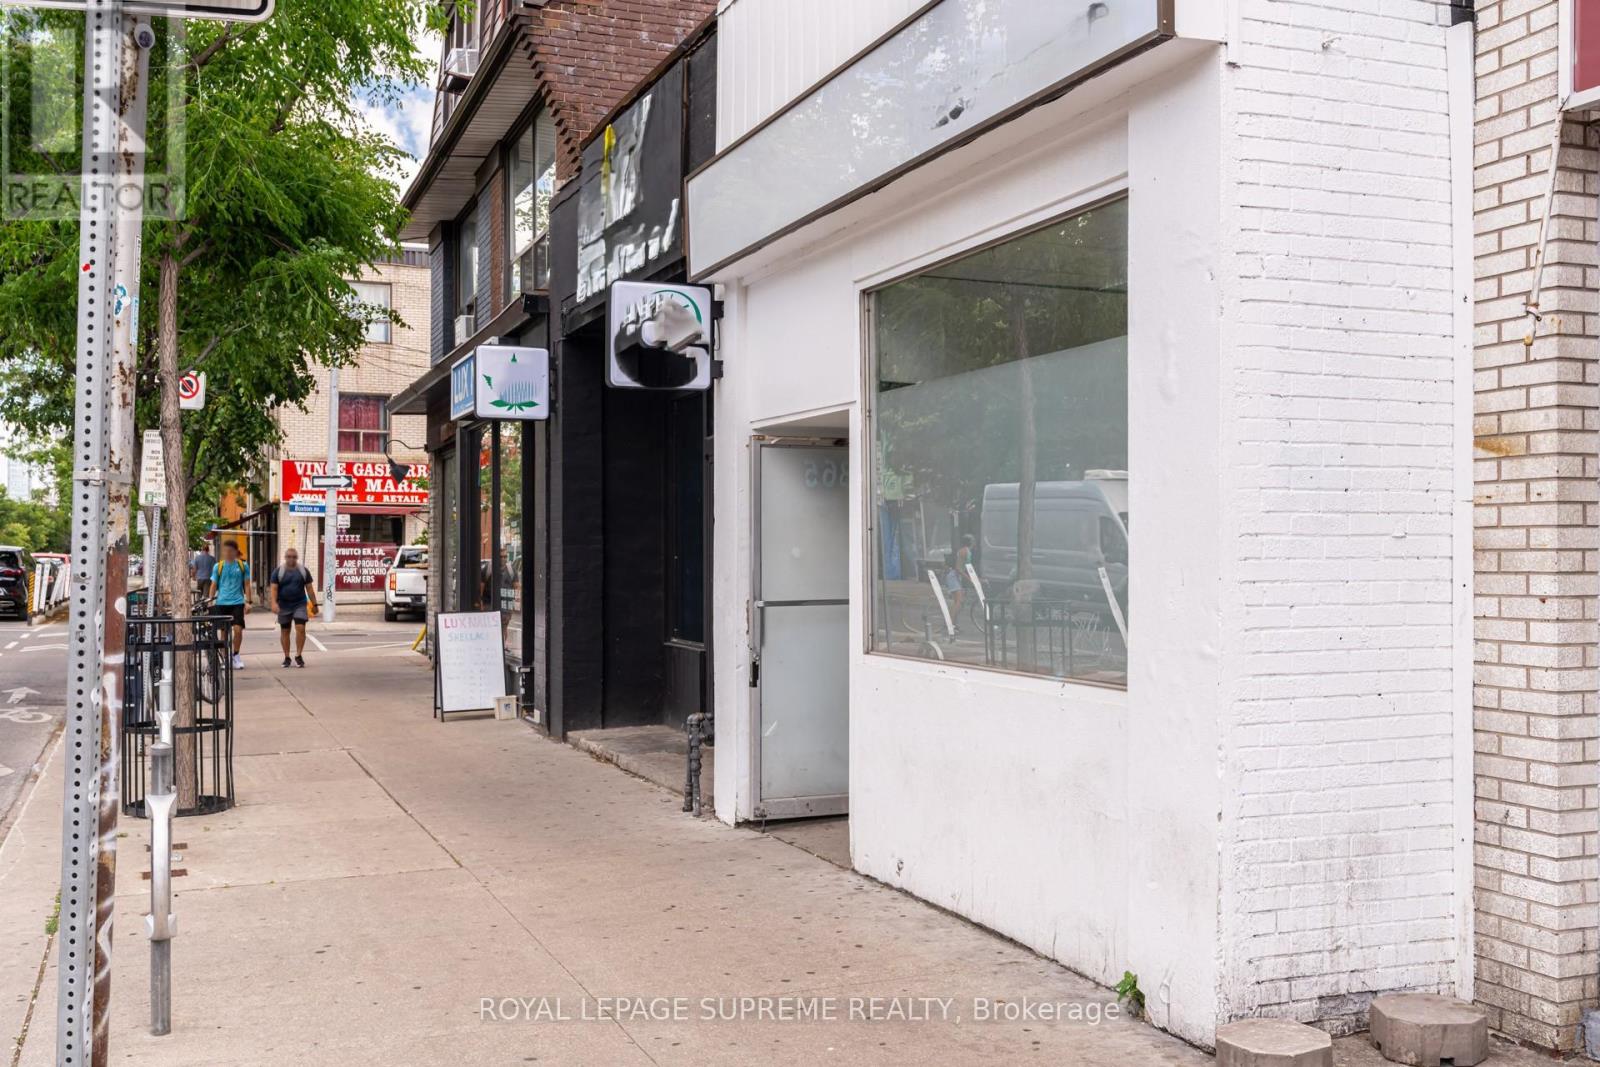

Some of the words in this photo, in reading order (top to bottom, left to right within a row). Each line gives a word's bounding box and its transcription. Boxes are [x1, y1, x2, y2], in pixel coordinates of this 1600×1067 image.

[294, 462, 346, 476] VINE
[291, 493, 358, 503] WHOLALE
[383, 495, 420, 504] RETAIL
[343, 559, 356, 568] ARE
[357, 559, 380, 568] PROUD
[343, 576, 376, 584] FARMERS
